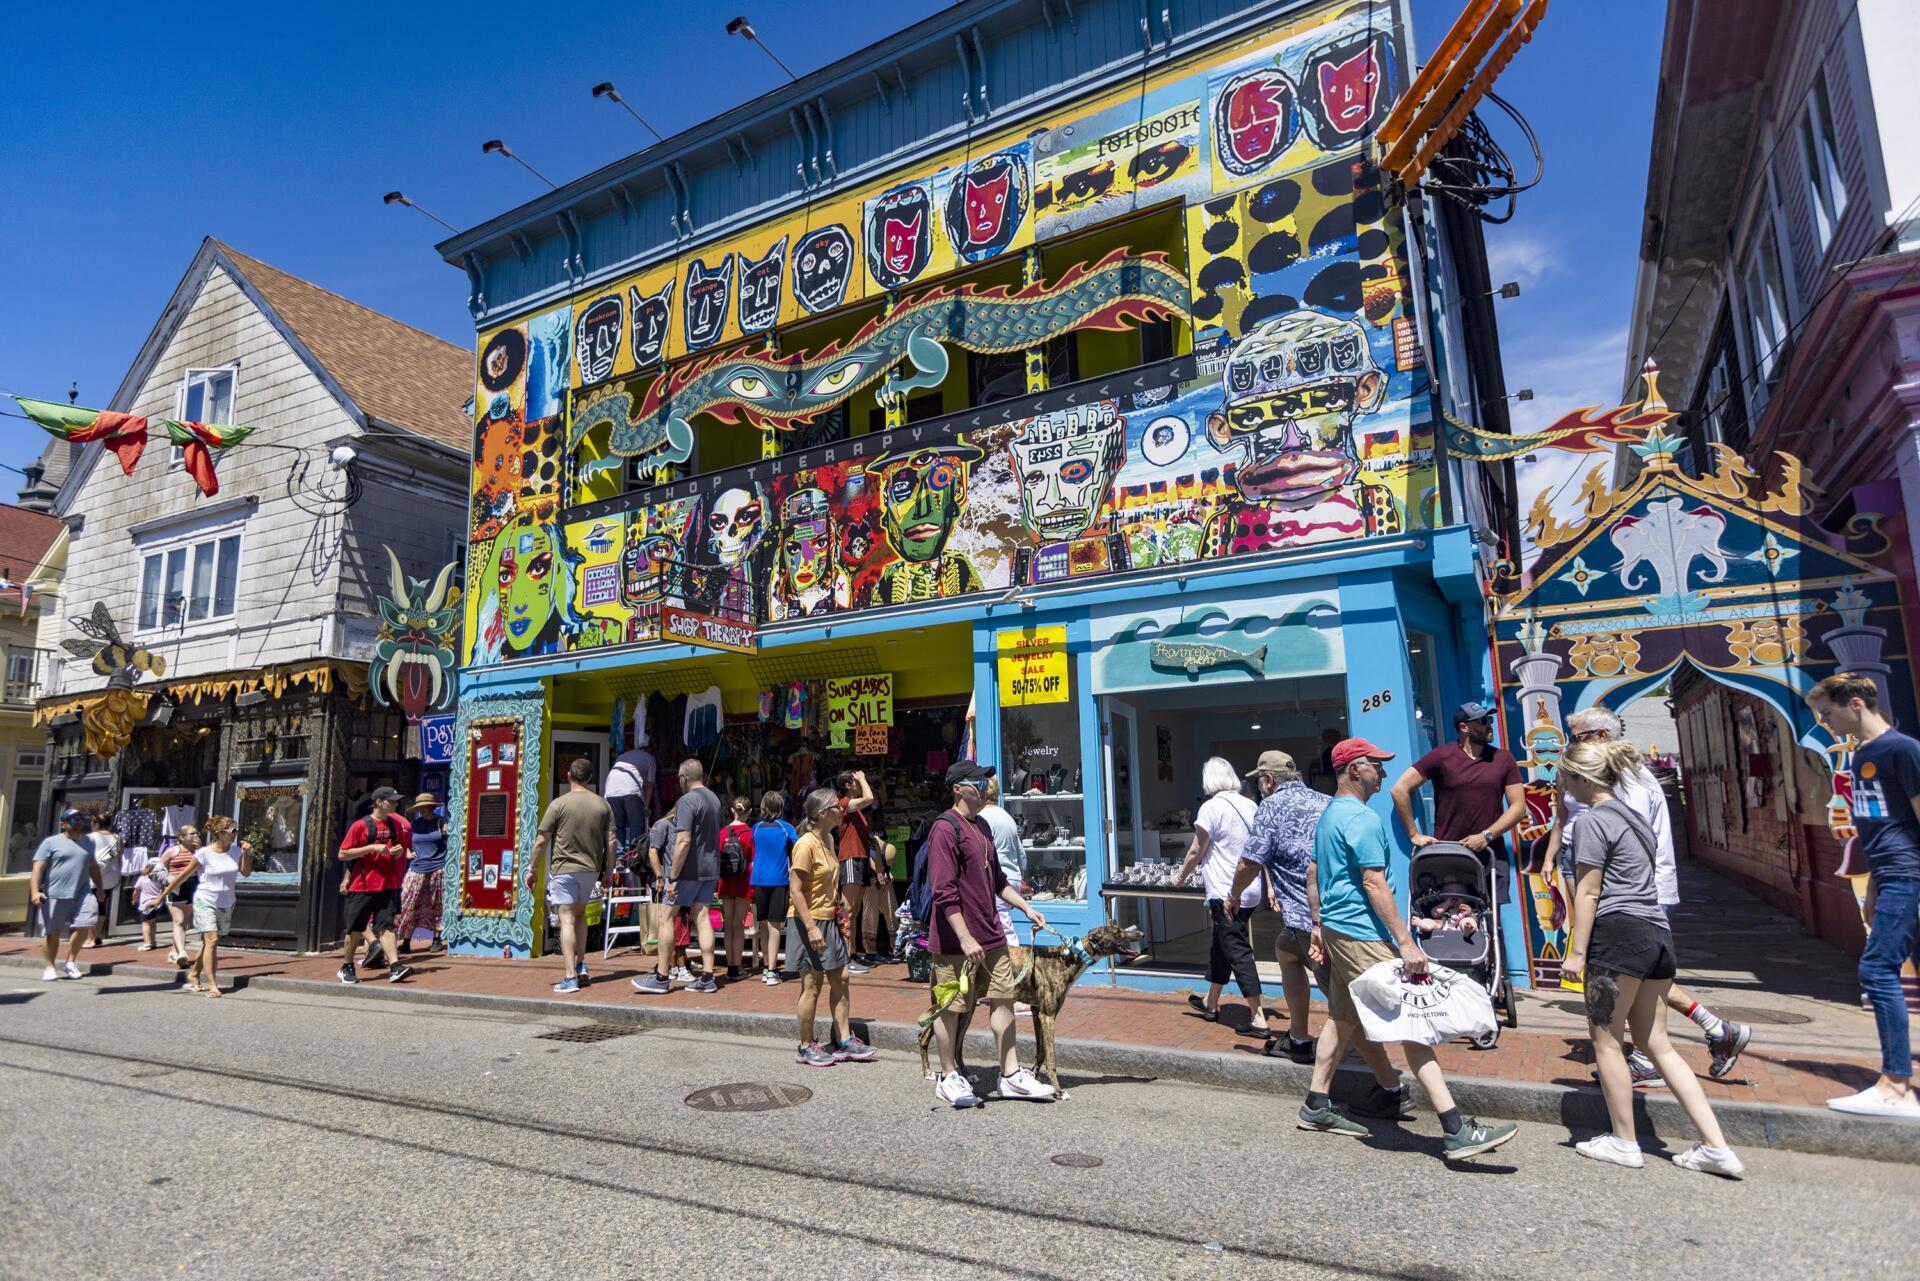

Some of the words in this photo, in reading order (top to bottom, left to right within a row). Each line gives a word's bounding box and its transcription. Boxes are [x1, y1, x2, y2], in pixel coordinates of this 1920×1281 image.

[815, 239, 830, 249] sky
[756, 267, 771, 276] cat
[693, 282, 718, 296] orange
[1195, 340, 1217, 351] Fragile
[1195, 351, 1217, 361] Liquid
[644, 476, 721, 504] SHOP
[748, 427, 922, 480] THERAPY
[538, 583, 549, 595] 3
[1728, 607, 1755, 619] ART
[669, 613, 699, 638] SHOP
[702, 621, 753, 648] THERAPY
[1016, 638, 1050, 648] SILVER
[1011, 650, 1055, 662] JEWELRY
[1021, 665, 1045, 675] SALE
[1012, 678, 1042, 695] 50-75%
[1043, 676, 1060, 692] OFF
[1362, 690, 1392, 713] 286
[847, 700, 888, 727] SALE
[1022, 745, 1059, 757] Jewelry
